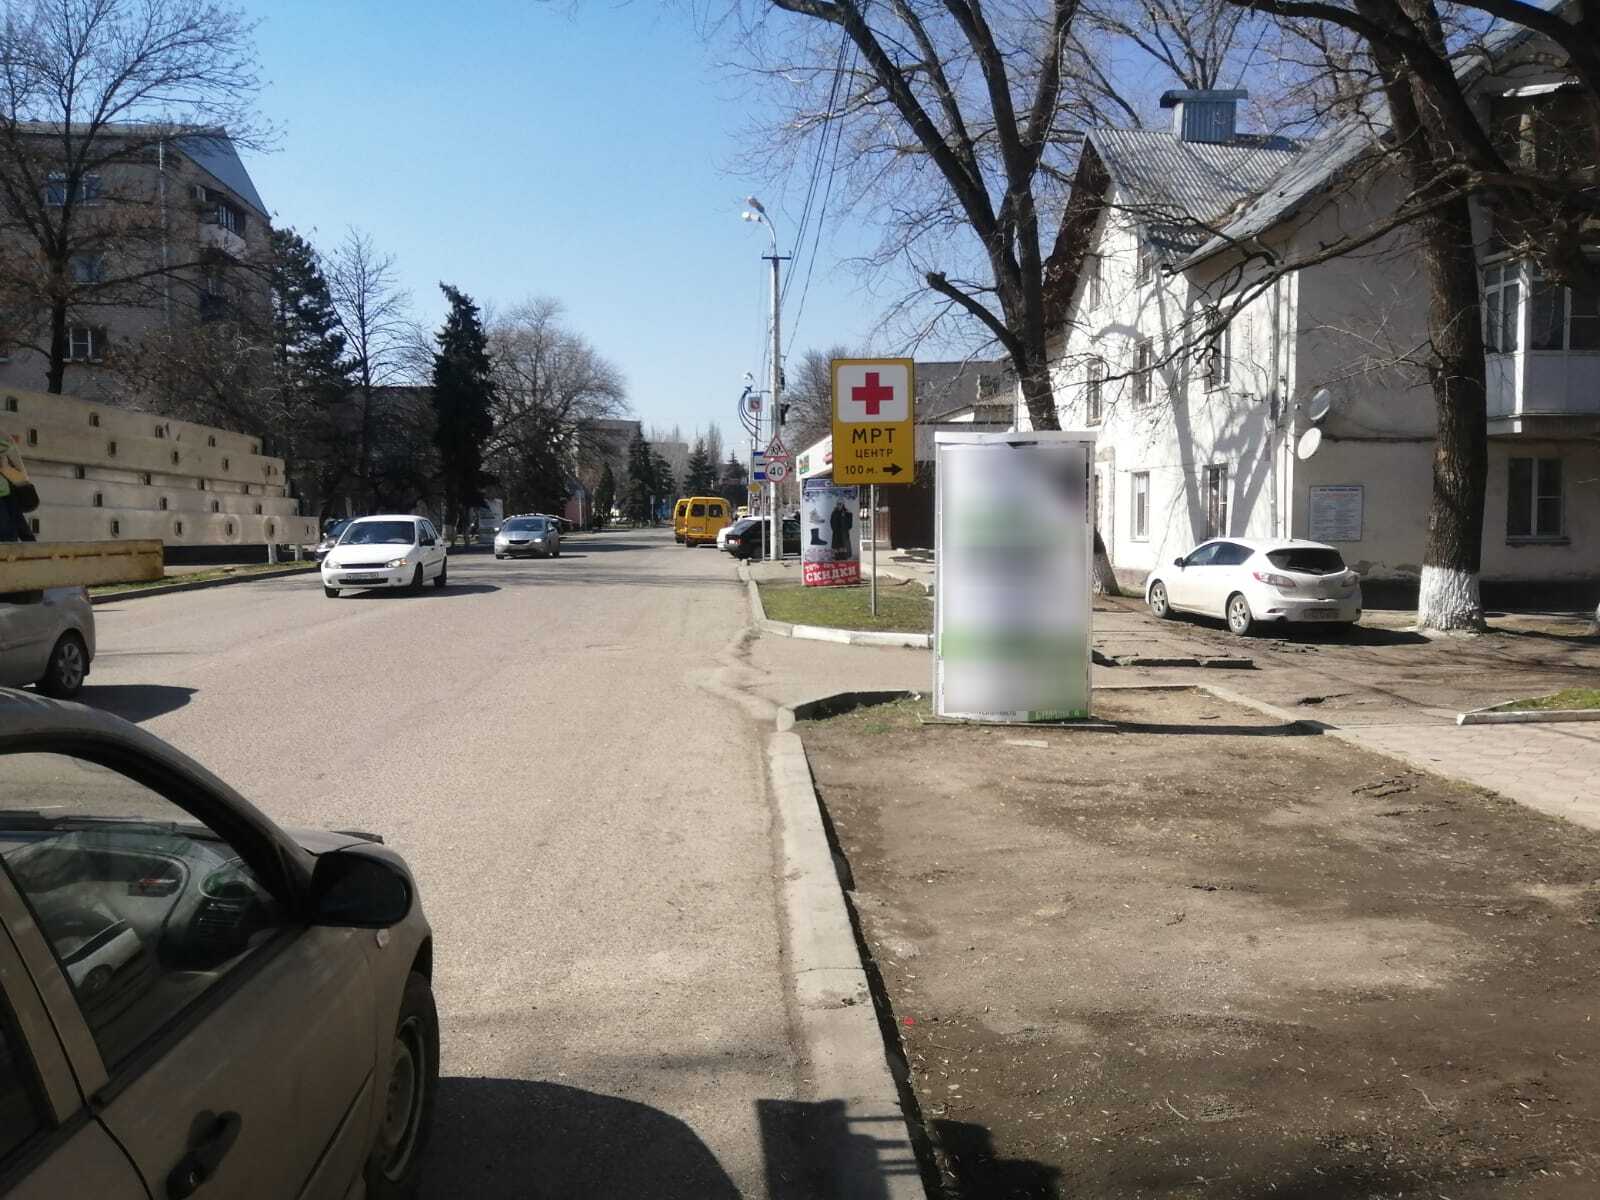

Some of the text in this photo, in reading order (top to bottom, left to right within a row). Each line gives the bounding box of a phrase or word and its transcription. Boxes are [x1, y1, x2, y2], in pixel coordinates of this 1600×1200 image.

[852, 427, 897, 445] МРТ
[855, 448, 894, 460] ЦЕНТР
[769, 466, 784, 476] 40
[845, 464, 864, 475] 100
[806, 566, 857, 582] СКИДКИ
